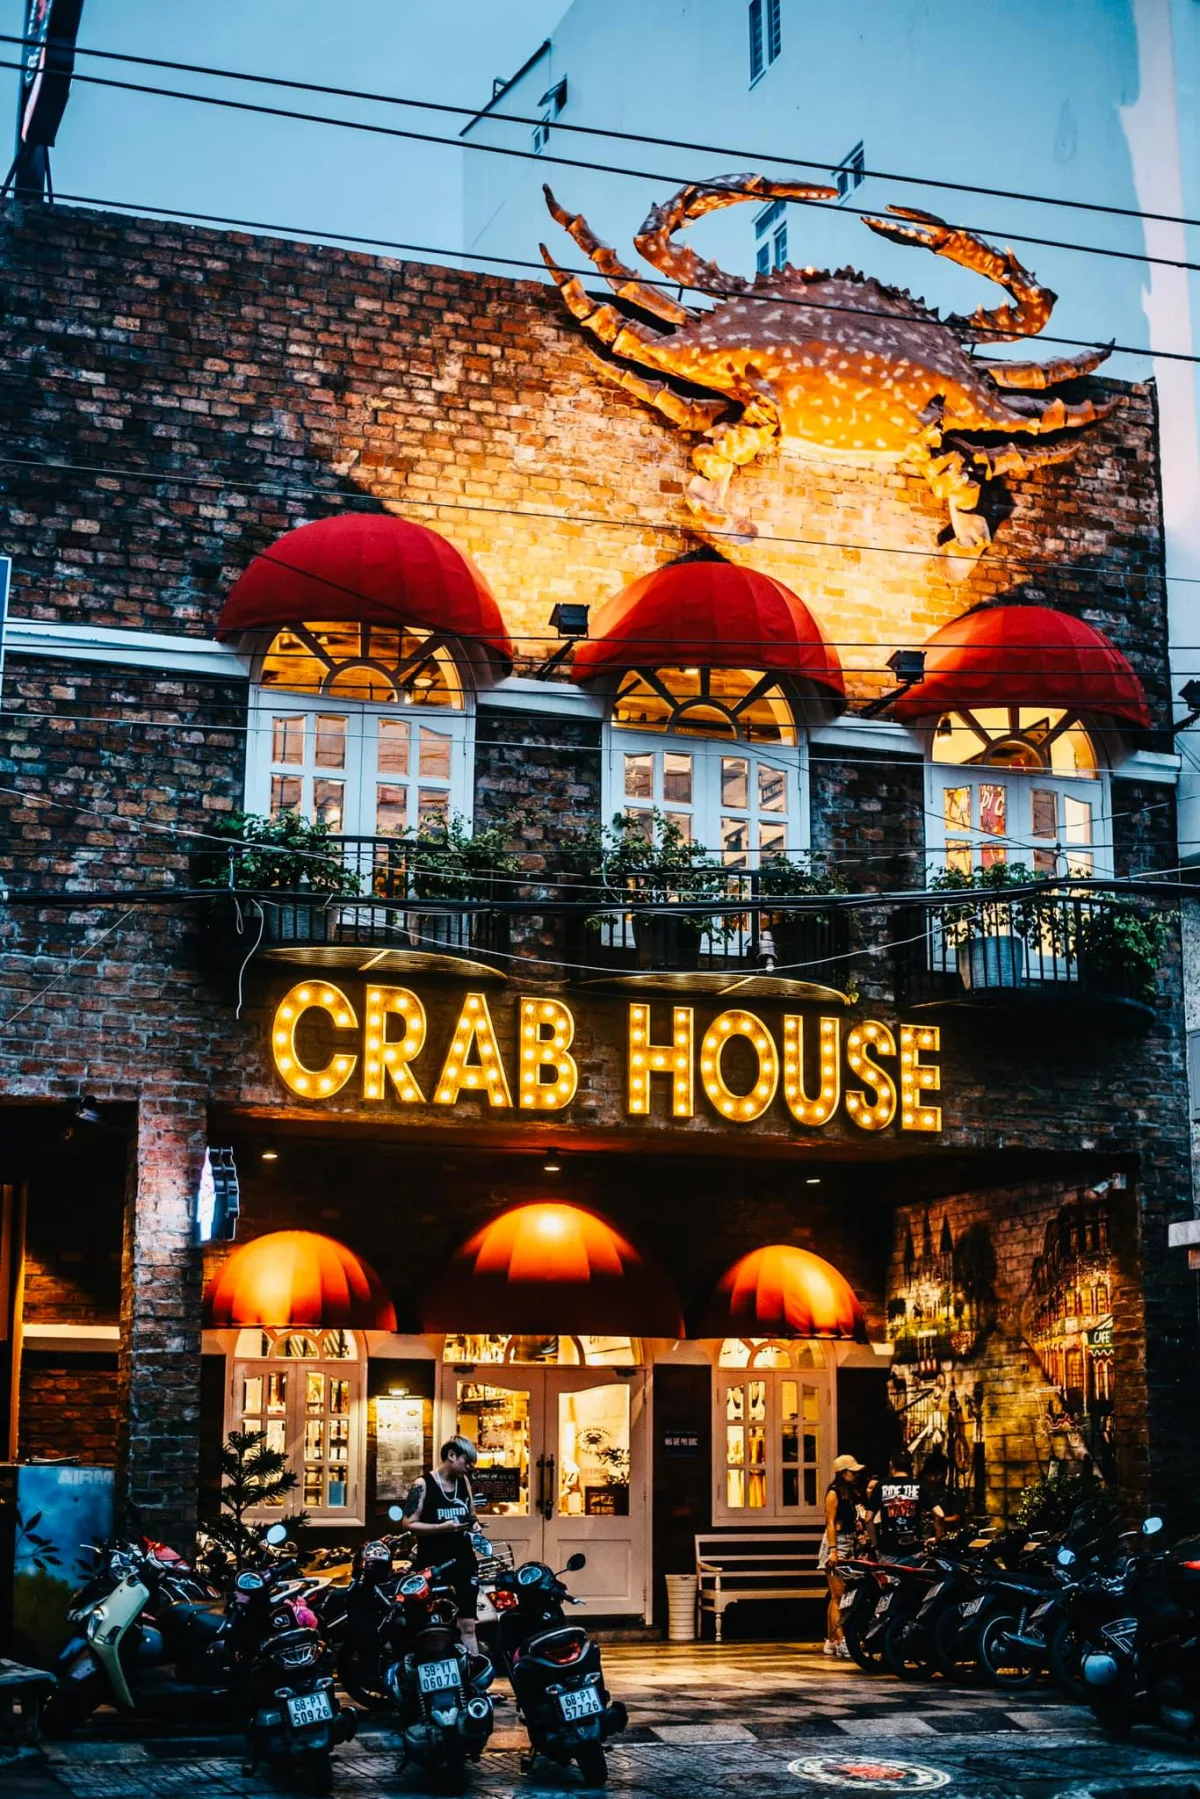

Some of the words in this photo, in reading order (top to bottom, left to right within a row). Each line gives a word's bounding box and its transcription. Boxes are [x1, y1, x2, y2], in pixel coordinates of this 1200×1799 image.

[272, 979, 578, 1110] CRAB
[629, 1003, 942, 1132] HOUSE
[1093, 1330, 1111, 1344] CAFE
[471, 1481, 516, 1498] OPEN
[881, 1484, 902, 1498] RIDE
[903, 1484, 920, 1498] THE
[424, 1661, 451, 1677] 59-Y1
[423, 1673, 458, 1690] 060.70
[294, 1695, 322, 1711] 68-P1
[565, 1690, 591, 1707] 68-P1
[294, 1706, 329, 1724] 509.26
[565, 1700, 599, 1719] 572.26
